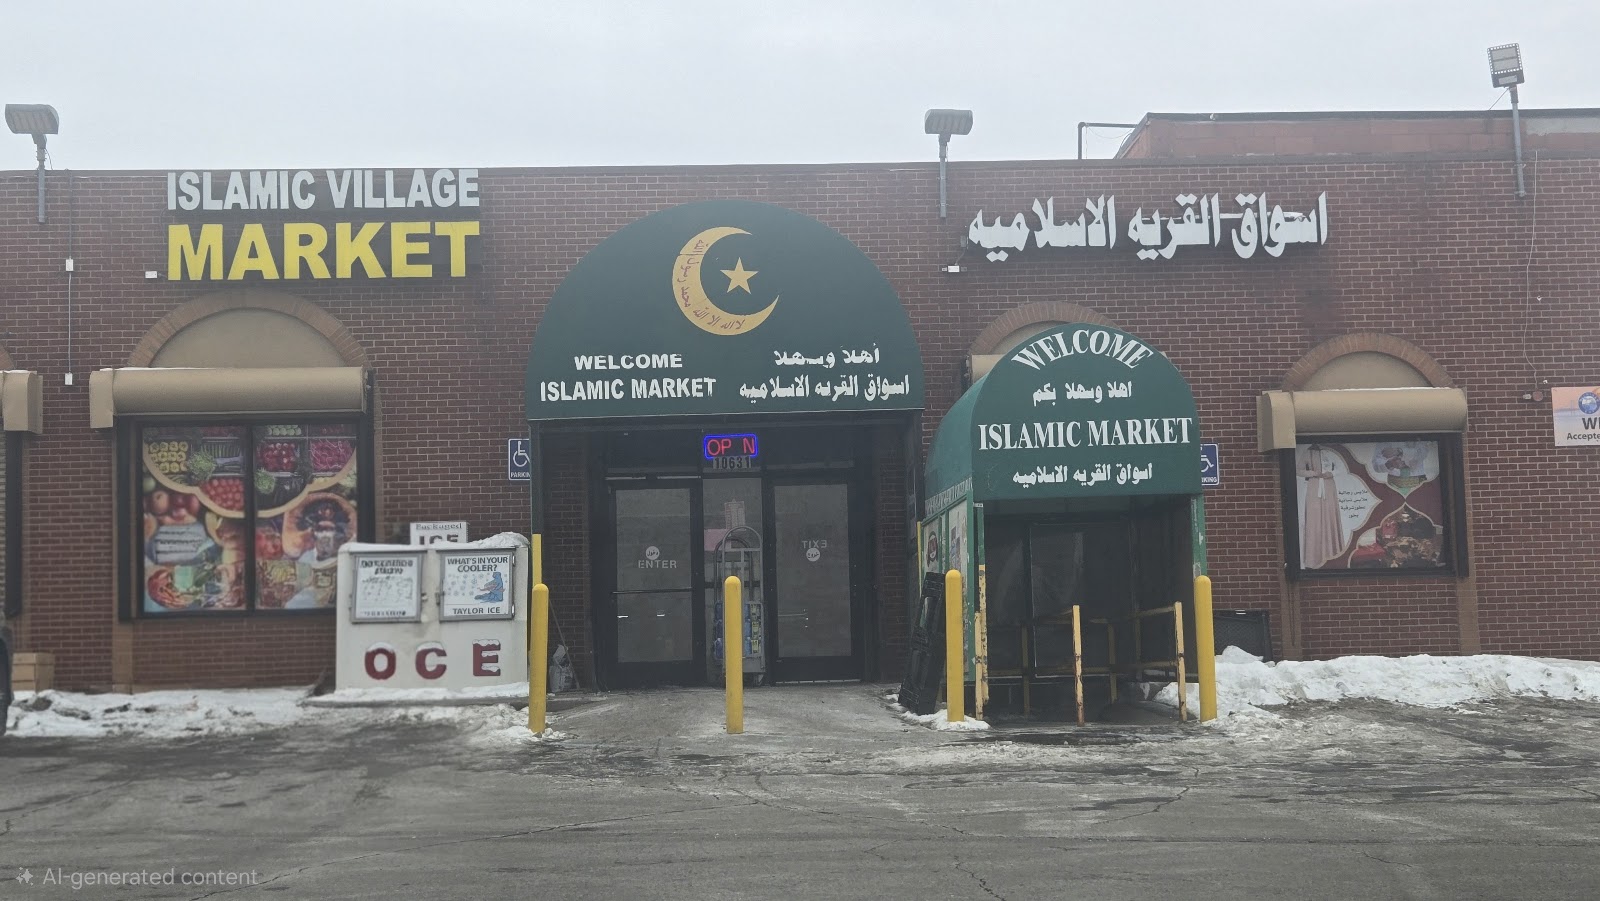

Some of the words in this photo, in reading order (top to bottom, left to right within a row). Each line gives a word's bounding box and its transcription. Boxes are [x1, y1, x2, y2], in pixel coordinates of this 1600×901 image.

[167, 170, 315, 210] ISLAMIC
[326, 169, 480, 208] VILLAGE
[1231, 191, 1328, 259] اسواق
[168, 221, 480, 281] MARKET
[1010, 329, 1154, 371] WELCOME
[574, 353, 683, 371] WELCOME
[540, 378, 624, 402] ISLAMIC
[631, 377, 716, 399] MARKET
[1032, 382, 1057, 407] بكم
[978, 421, 1081, 451] ISLAMIC
[1087, 417, 1192, 446] MARKET
[1581, 417, 1600, 430] W
[714, 456, 752, 469] 10631
[1116, 462, 1153, 485] اسواق
[447, 557, 477, 565] WHAT'S
[487, 556, 508, 564] YOUR
[457, 564, 498, 573] COOLER?
[638, 560, 677, 569] ENTER
[452, 607, 484, 615] TAYLOR
[488, 606, 501, 614] ICE
